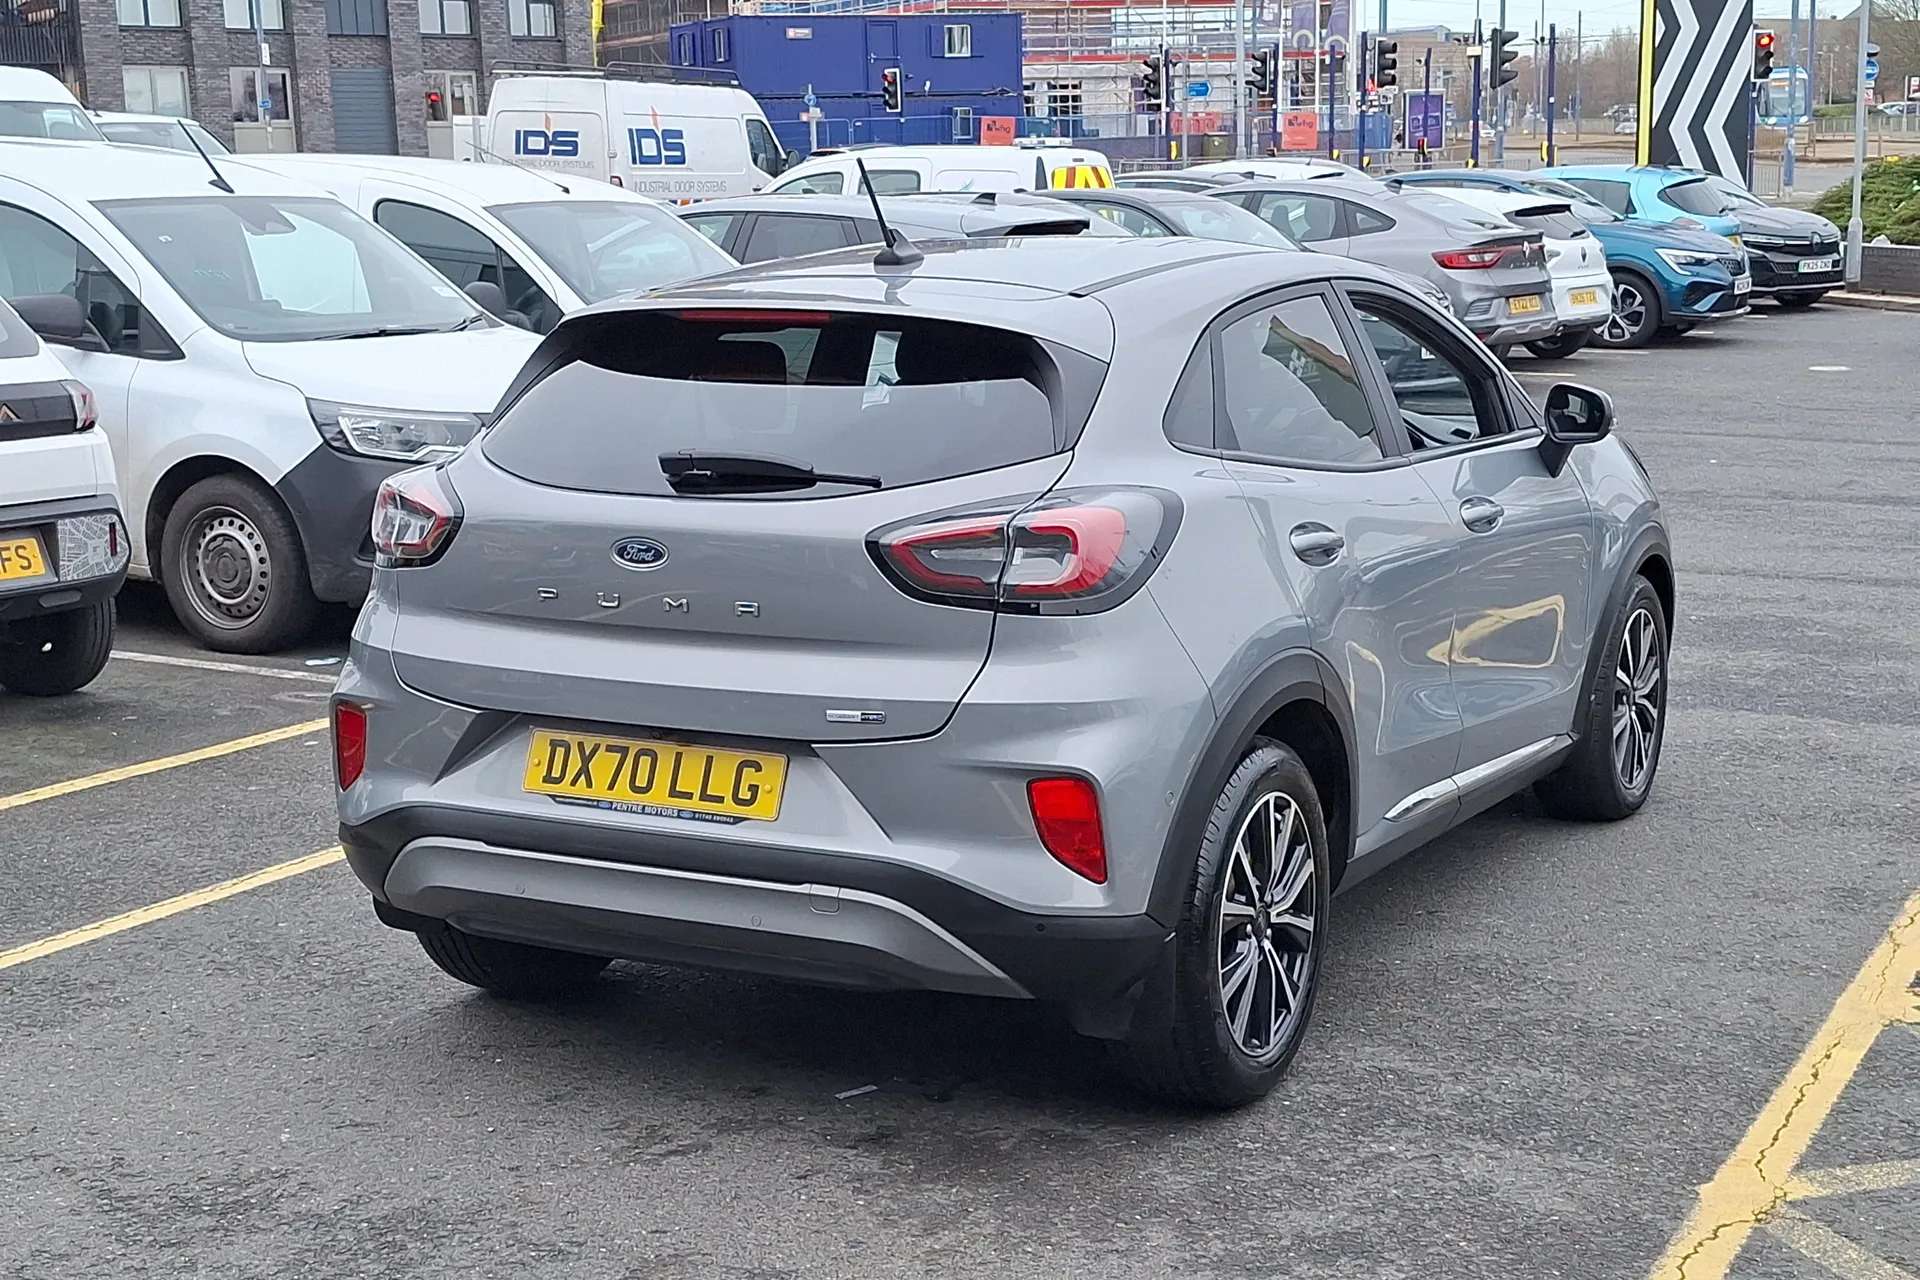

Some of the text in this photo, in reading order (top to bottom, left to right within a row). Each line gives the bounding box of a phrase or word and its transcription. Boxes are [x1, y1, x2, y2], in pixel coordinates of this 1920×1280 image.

[515, 130, 579, 157] IDS
[627, 128, 686, 165] IDS
[539, 159, 559, 168] DOOR
[562, 160, 595, 169] SYSTEMS
[674, 181, 695, 192] DOOR
[696, 181, 727, 192] SYSTEMS
[0, 544, 32, 574] FS
[537, 587, 760, 617] PUMA
[542, 738, 763, 808] DX70 LLG
[611, 802, 643, 814] PENTRE
[645, 805, 678, 818] MOTORS
